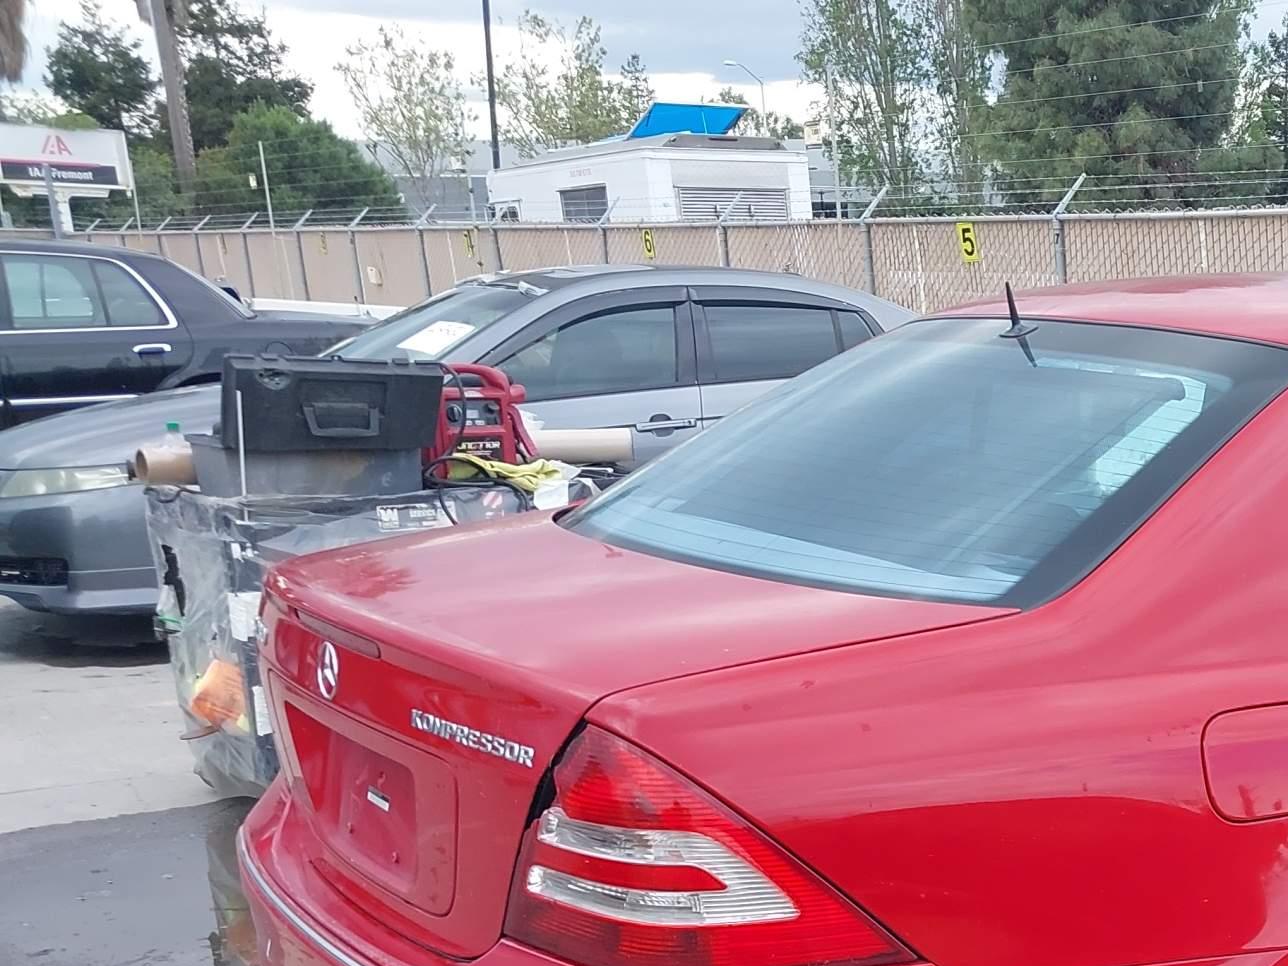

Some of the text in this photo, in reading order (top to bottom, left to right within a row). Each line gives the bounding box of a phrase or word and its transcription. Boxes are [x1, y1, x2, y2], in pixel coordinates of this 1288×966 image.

[644, 230, 652, 253] 6
[962, 227, 975, 256] 5
[410, 708, 535, 768] KOMPRESSOR
